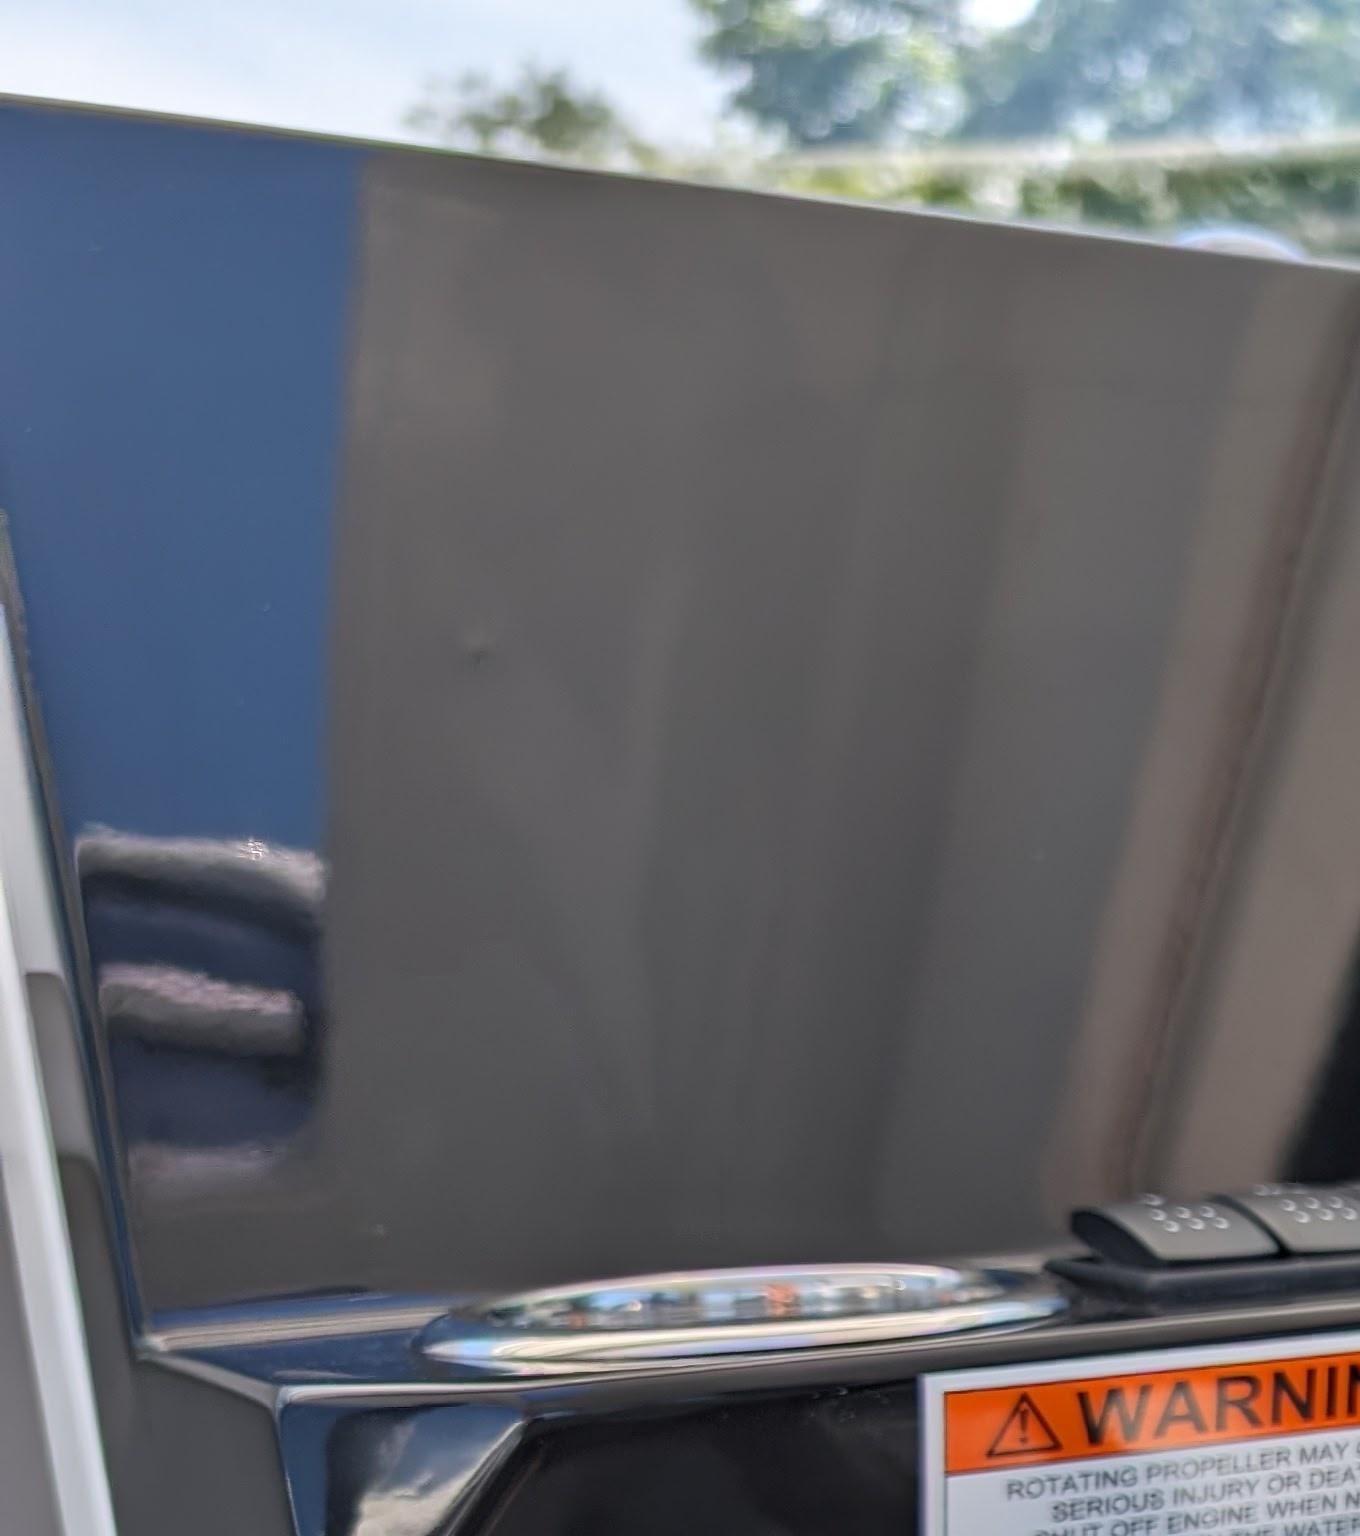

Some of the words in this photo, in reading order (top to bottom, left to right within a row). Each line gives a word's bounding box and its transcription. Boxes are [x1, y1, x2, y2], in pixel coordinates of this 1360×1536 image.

[1006, 1465, 1138, 1501] ROTATING
[1146, 1446, 1292, 1482] PROPELLER
[1299, 1440, 1349, 1465] MAY
[1052, 1489, 1165, 1523] SERIOUS
[1173, 1475, 1260, 1506] INJURY
[1267, 1472, 1302, 1495] OR
[1166, 1501, 1257, 1535] ENGINE
[1267, 1495, 1338, 1529] WHEN
